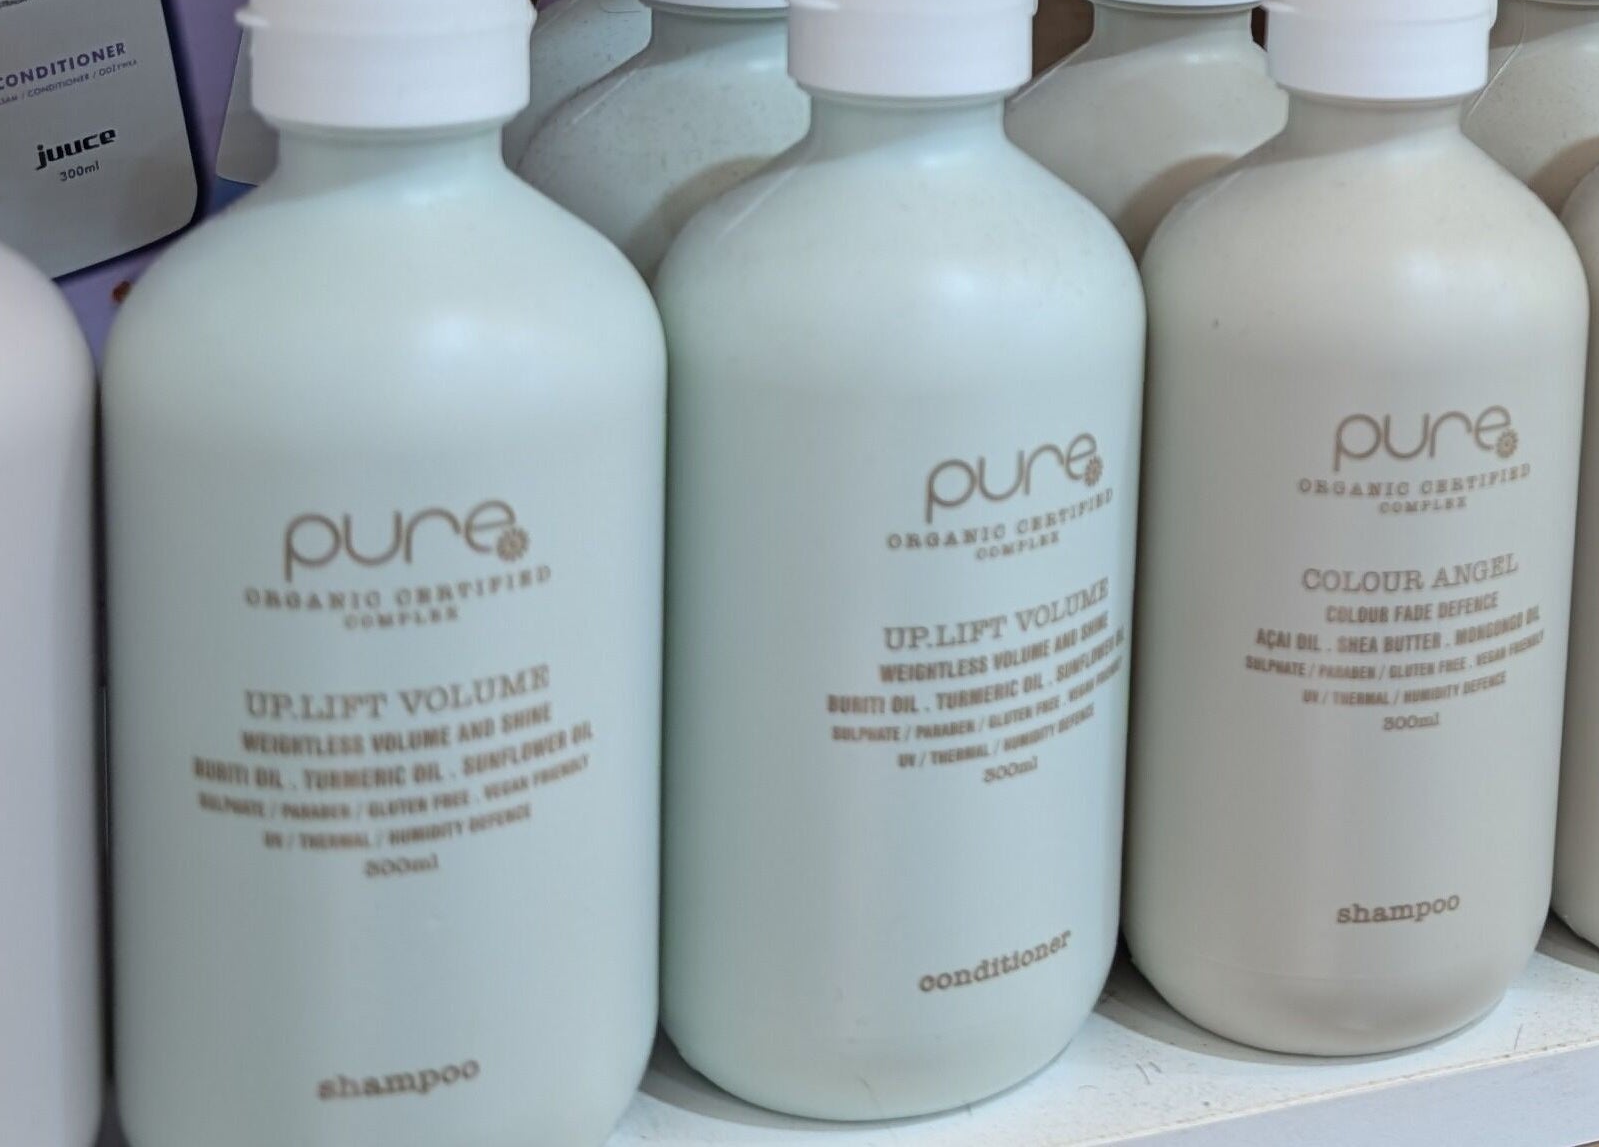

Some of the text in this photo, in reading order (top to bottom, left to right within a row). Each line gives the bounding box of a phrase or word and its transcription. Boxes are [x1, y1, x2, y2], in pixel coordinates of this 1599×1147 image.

[28, 73, 90, 97] CONDITIONER
[35, 129, 116, 171] juuce
[60, 160, 100, 182] 300ml
[1333, 405, 1512, 473] pure
[925, 432, 1097, 524] pure
[1298, 463, 1531, 496] ORGANIC CERTIFIED
[284, 499, 517, 583] pure
[887, 488, 1113, 551] ORGANIC CERTIFIED
[395, 565, 552, 606] CERTIFIED
[1301, 553, 1519, 593] COLOUR ANGEL
[883, 576, 1109, 650] UP.LIFT VOLUME
[1325, 603, 1433, 624] COLOUR FADE
[878, 638, 1050, 683] WEIGHTLESS VOLUME
[399, 663, 551, 717] VOLUME
[1336, 894, 1460, 924] shampoo
[919, 929, 1072, 993] conditioner
